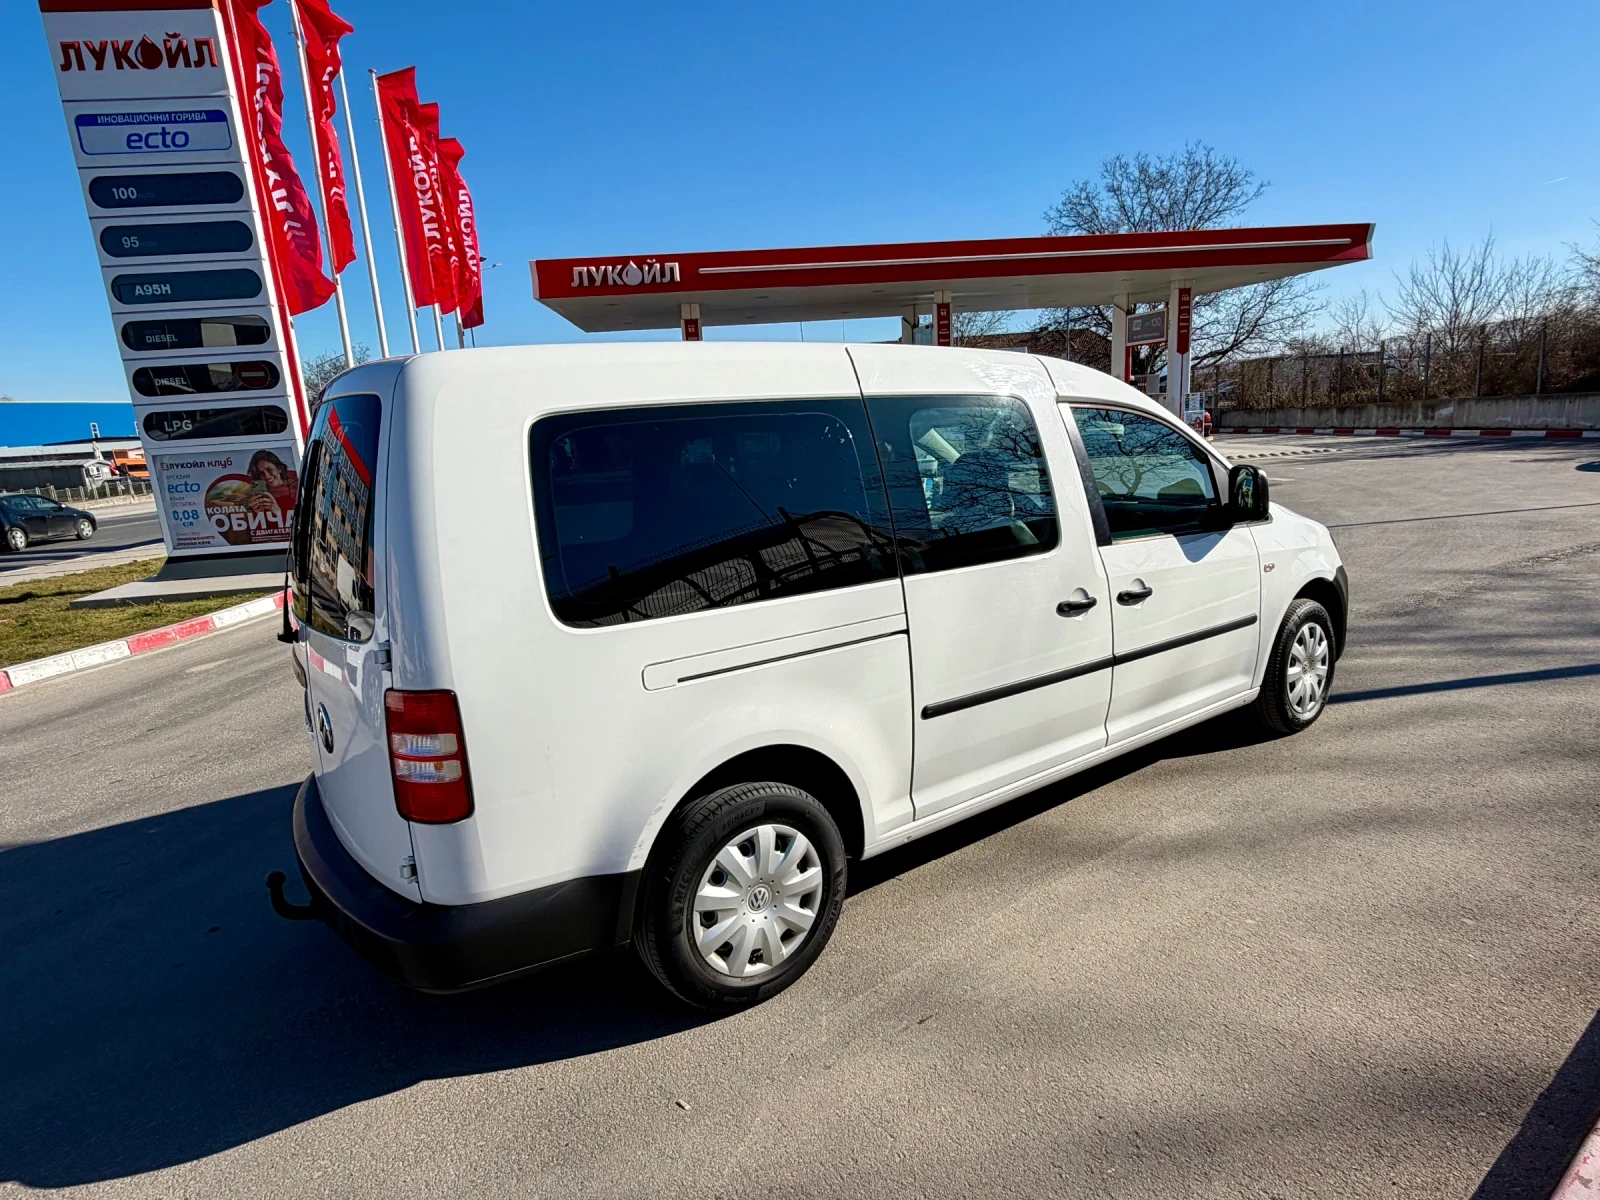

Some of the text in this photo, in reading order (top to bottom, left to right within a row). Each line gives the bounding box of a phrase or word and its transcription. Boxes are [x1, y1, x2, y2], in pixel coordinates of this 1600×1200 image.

[60, 32, 218, 71] ЛУКОЙЛ
[97, 111, 207, 123] ИНОВАЦИОННИ ГОРИВА
[126, 126, 190, 150] ecto
[111, 187, 137, 200] 100
[121, 236, 140, 248] 95
[571, 258, 681, 288] ЛУКОЙЛ
[134, 283, 172, 296] A95H
[145, 334, 178, 343] DIESEL
[154, 377, 188, 386] DIESEL
[163, 419, 193, 432] LPG
[168, 457, 233, 470] ЛУКОЙЛ клуб
[167, 480, 201, 494] ecto
[172, 509, 200, 523] 0,08
[206, 505, 247, 515] КОЛАТА
